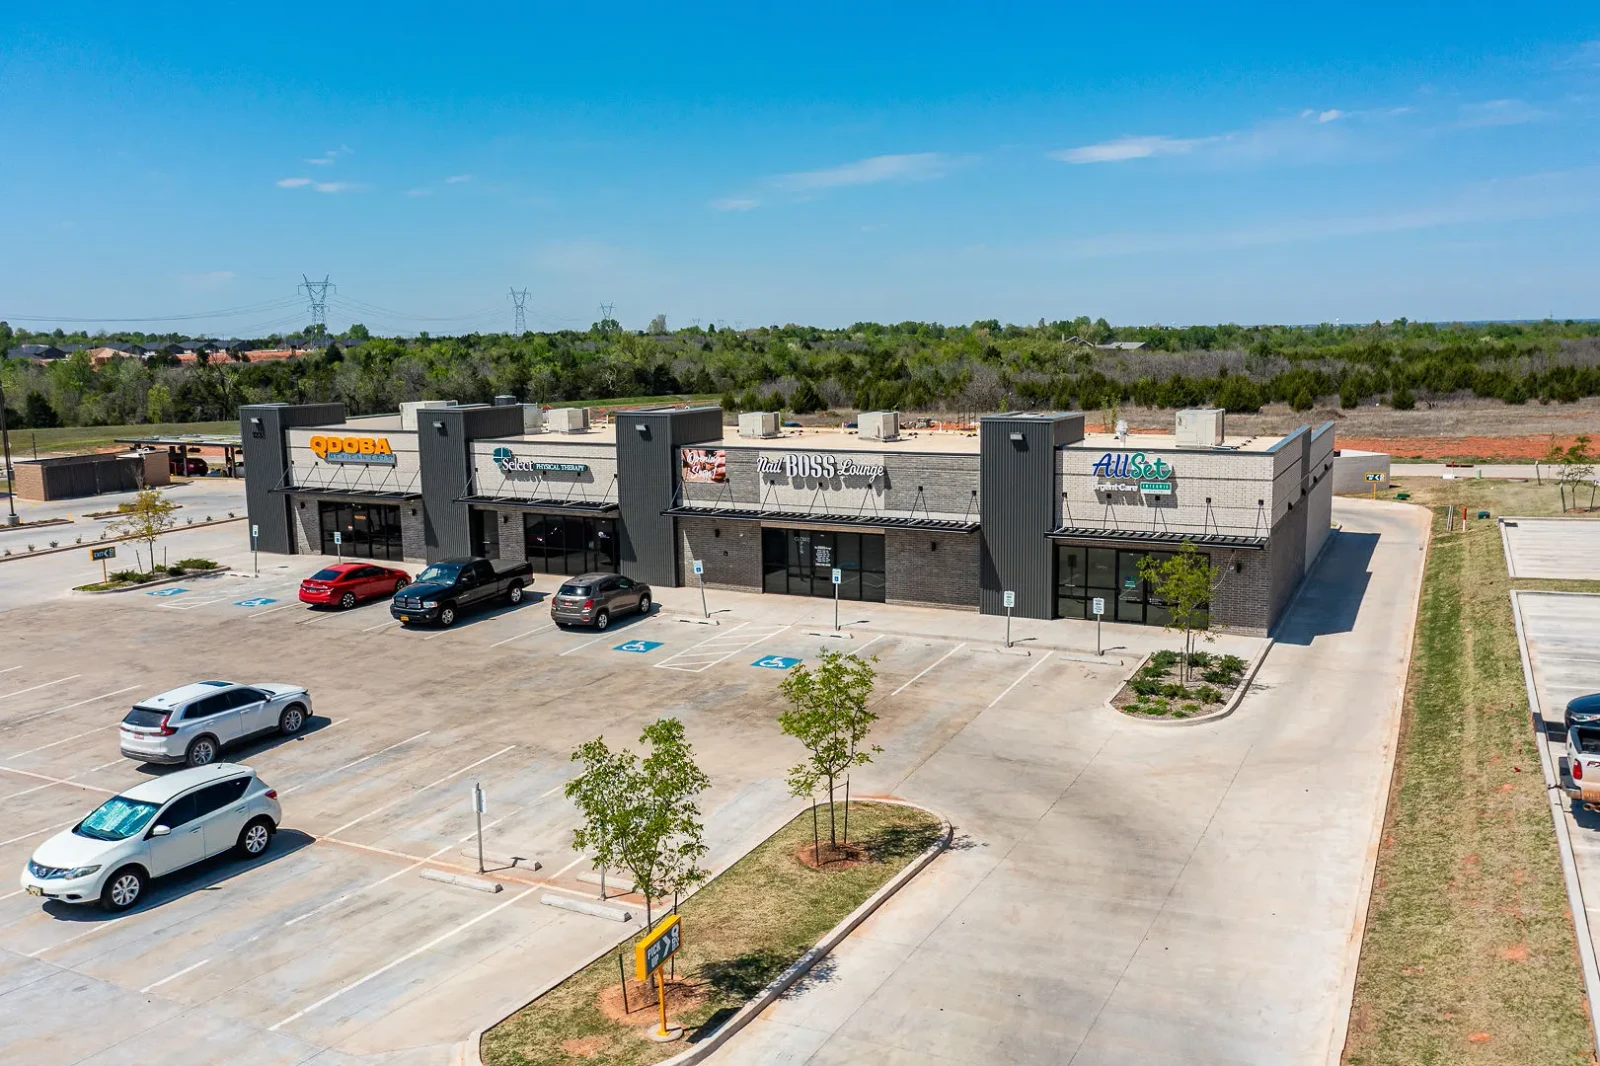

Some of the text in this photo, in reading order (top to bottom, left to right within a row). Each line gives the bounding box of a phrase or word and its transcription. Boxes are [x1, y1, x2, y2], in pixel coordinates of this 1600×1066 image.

[310, 435, 392, 459] QDOBA
[329, 453, 394, 462] MEXICAN EATS
[502, 457, 534, 472] Select
[1092, 452, 1172, 480] AllSet
[535, 463, 585, 472] PHYSICAL THERAPY
[757, 453, 884, 483] Nail BOSS Lounge
[1119, 483, 1138, 492] Care
[647, 940, 661, 960] PICK
